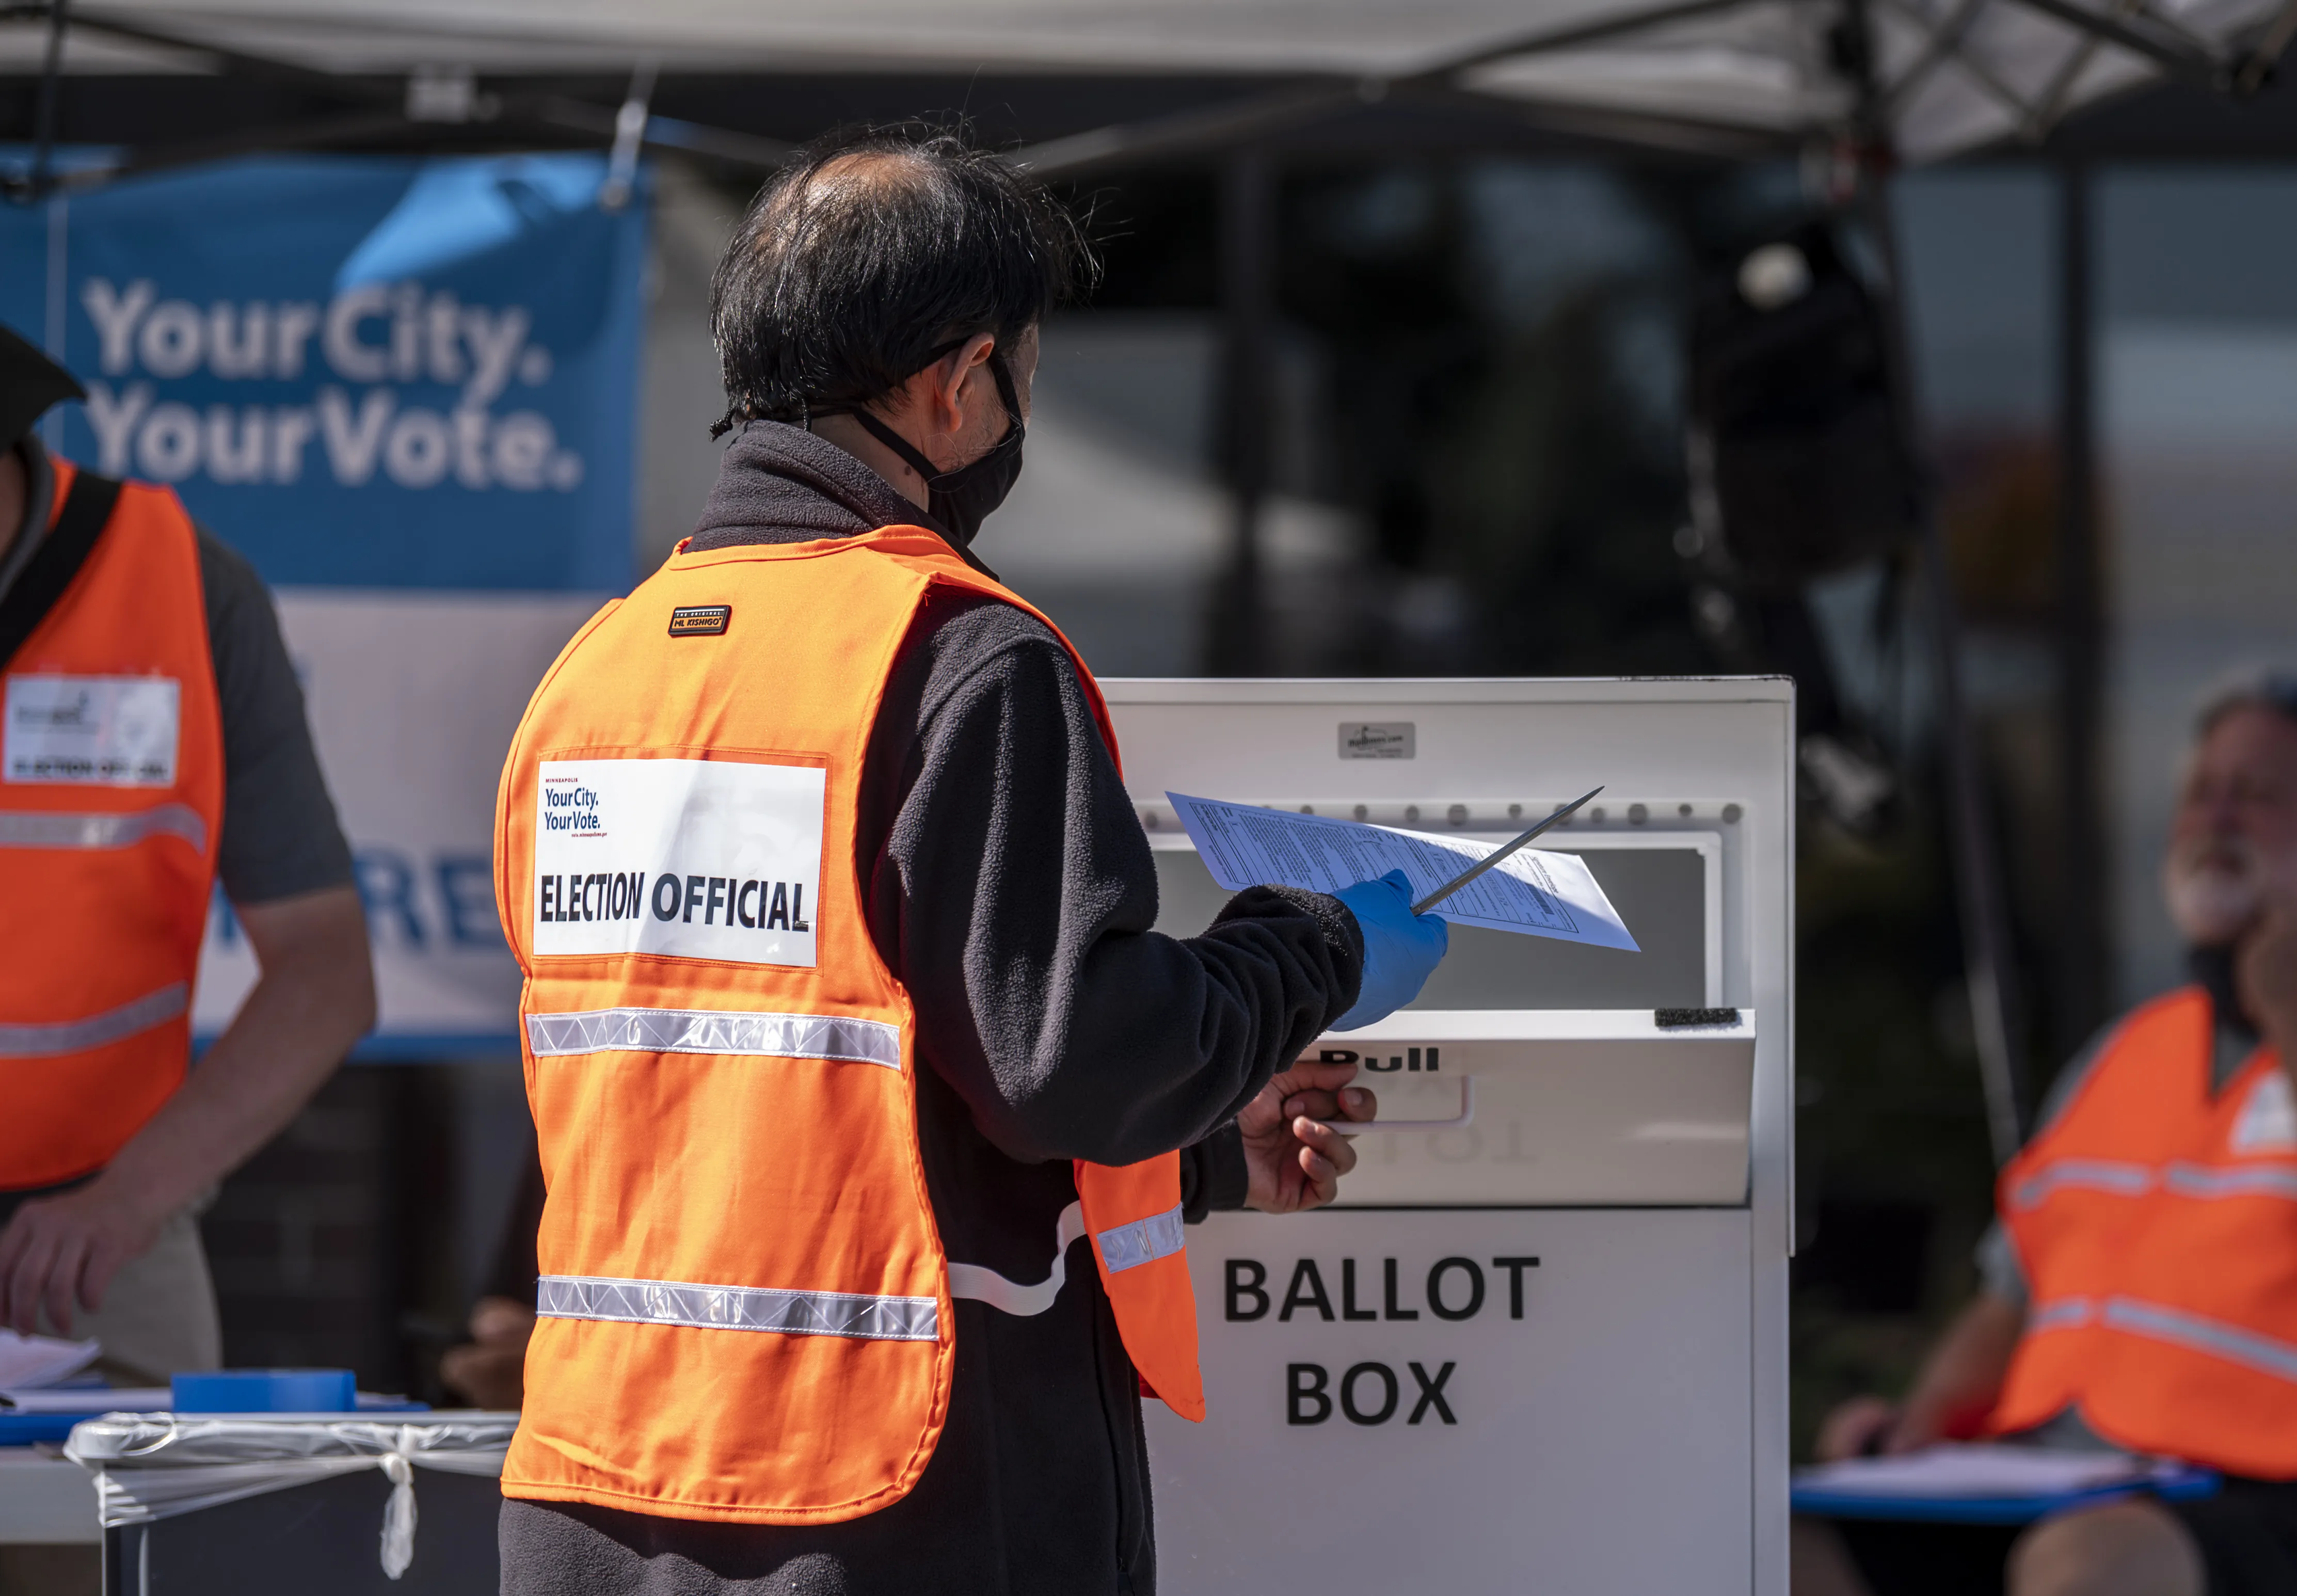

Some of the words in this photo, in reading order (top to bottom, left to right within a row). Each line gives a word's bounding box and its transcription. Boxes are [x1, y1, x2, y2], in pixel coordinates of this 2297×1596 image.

[83, 277, 317, 379] Your
[323, 280, 551, 408] City.
[86, 382, 311, 484] Your
[318, 387, 583, 489] Vote.
[545, 811, 572, 830] Your
[572, 811, 600, 829] Vote.
[546, 788, 573, 807] Your
[574, 787, 598, 811] City.
[540, 872, 645, 922] ELECTION
[651, 873, 809, 932] OFFICIAL
[1224, 1256, 1541, 1322] BALLOT
[1286, 1361, 1458, 1426] BOX
